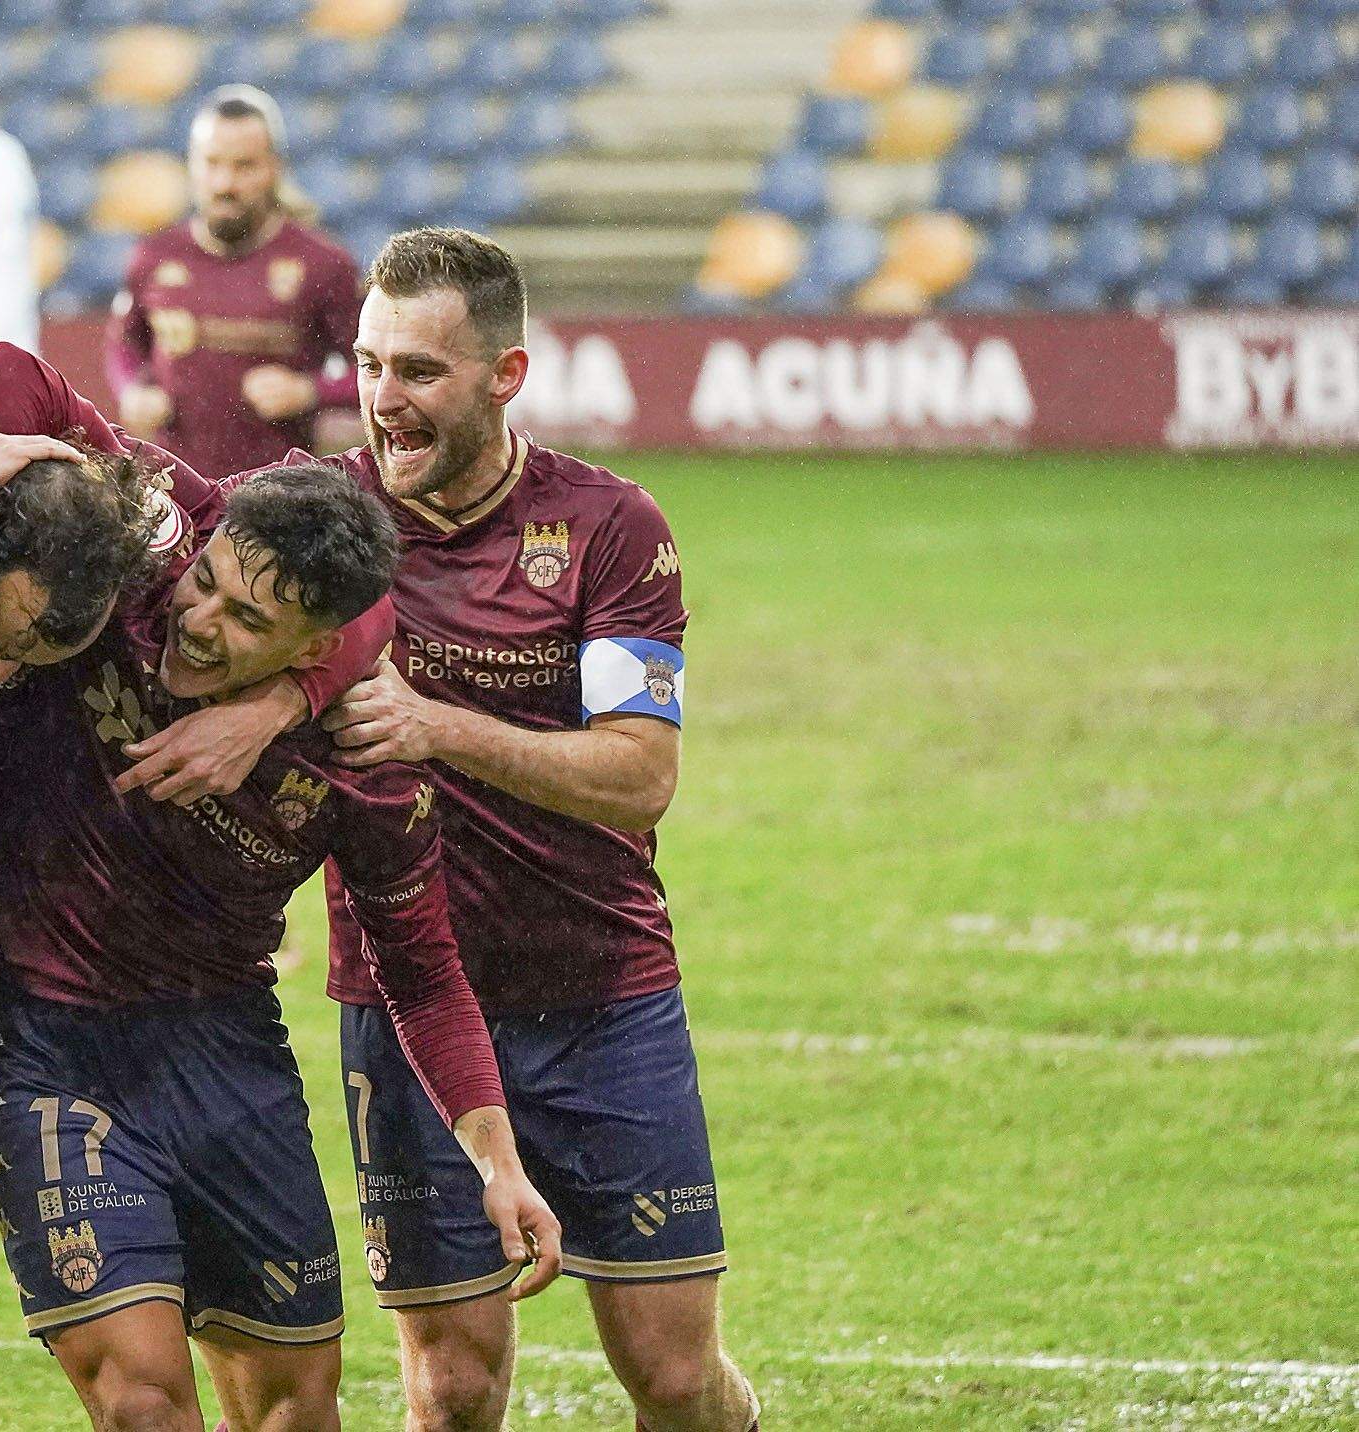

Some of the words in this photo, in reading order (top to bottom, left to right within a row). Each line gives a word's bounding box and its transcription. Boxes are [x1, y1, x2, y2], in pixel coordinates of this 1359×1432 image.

[406, 633, 578, 667] Deputación
[388, 881, 425, 903] VOLTAR
[348, 1071, 373, 1164] 7
[28, 1097, 113, 1182] 17
[367, 1174, 406, 1188] XUNTA
[67, 1182, 118, 1199] XUNTA
[368, 1188, 382, 1202] DE
[384, 1186, 440, 1202] GALICIA
[671, 1184, 715, 1200] DEPORTE
[68, 1200, 89, 1213] DE
[93, 1194, 147, 1209] GALICIA
[672, 1198, 713, 1214] GALEGO
[72, 1267, 88, 1281] CF
